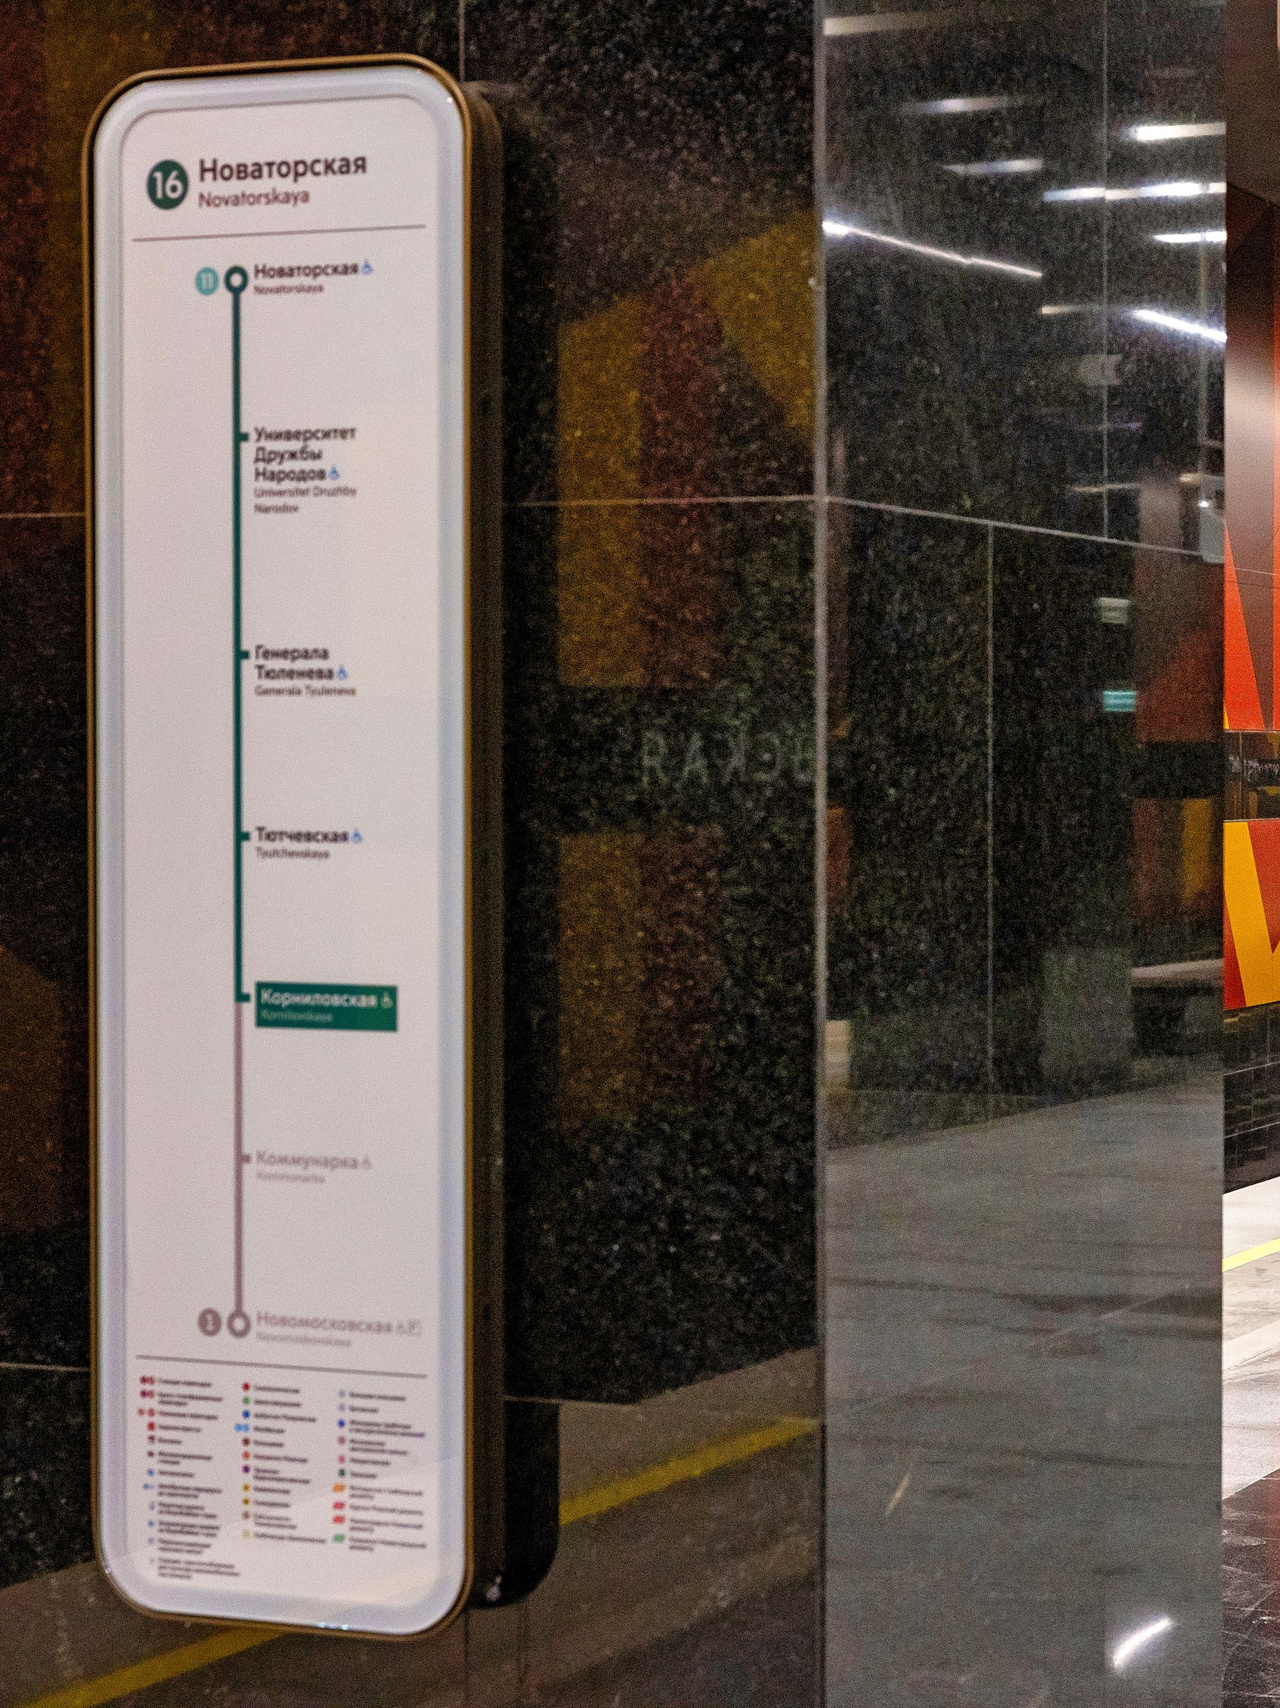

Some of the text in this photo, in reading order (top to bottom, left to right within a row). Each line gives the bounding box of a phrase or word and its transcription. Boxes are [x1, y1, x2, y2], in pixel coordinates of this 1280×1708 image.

[199, 156, 368, 183] Новаторская
[152, 170, 184, 200] 16
[198, 188, 310, 209] Novatorskaya
[254, 263, 359, 280] Новаторская
[254, 427, 357, 443] Университет
[253, 445, 323, 465] Дружбы
[254, 468, 327, 484] Народов
[254, 644, 330, 662] Генерала
[254, 664, 335, 680] Тюленева
[255, 826, 350, 844] Тютчевская
[260, 988, 378, 1009] Корниловская
[255, 1150, 360, 1171] Коммунарка
[256, 1311, 394, 1334] Новомосковская
